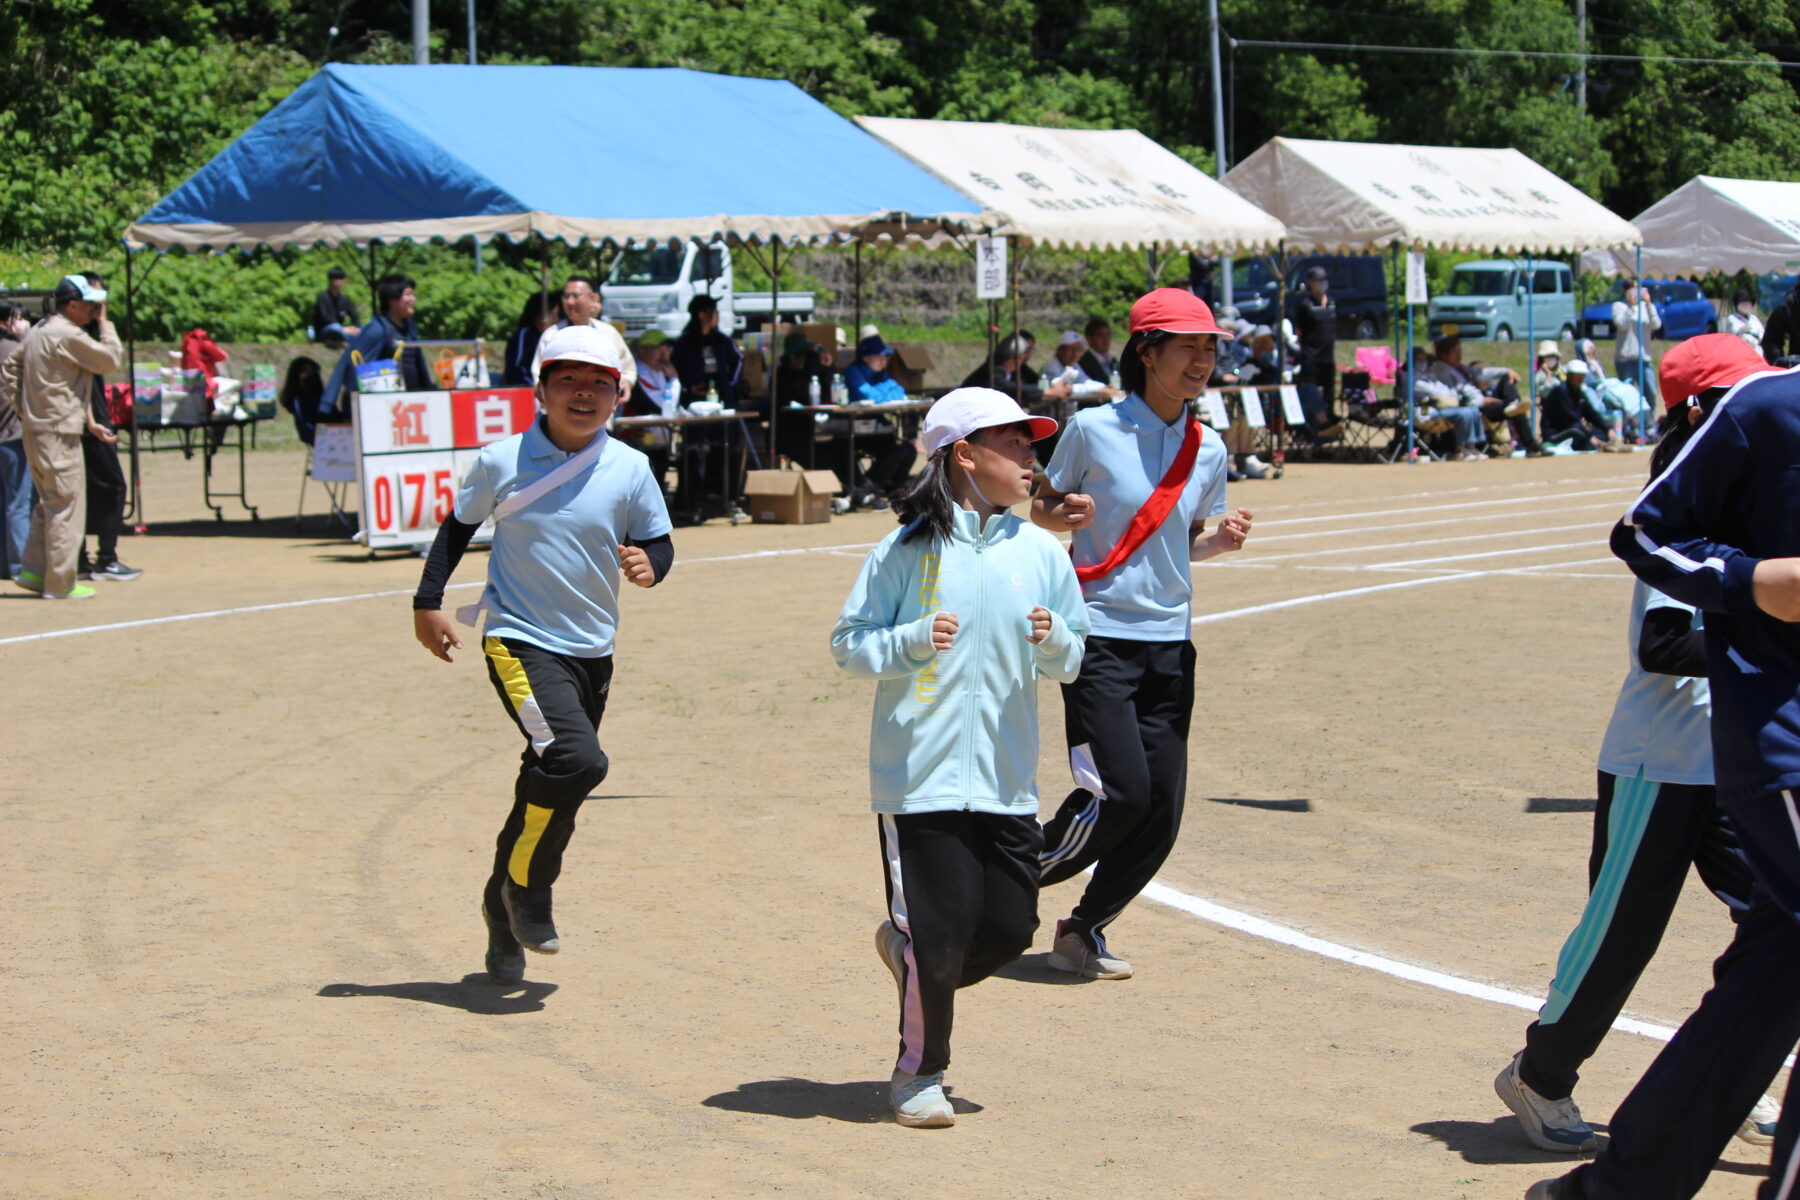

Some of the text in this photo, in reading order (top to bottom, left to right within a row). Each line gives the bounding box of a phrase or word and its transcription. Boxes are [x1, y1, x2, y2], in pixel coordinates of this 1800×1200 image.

[983, 243, 1001, 291] 本部
[391, 400, 430, 446] 紅
[474, 395, 513, 443] 白
[374, 469, 454, 531] 075
